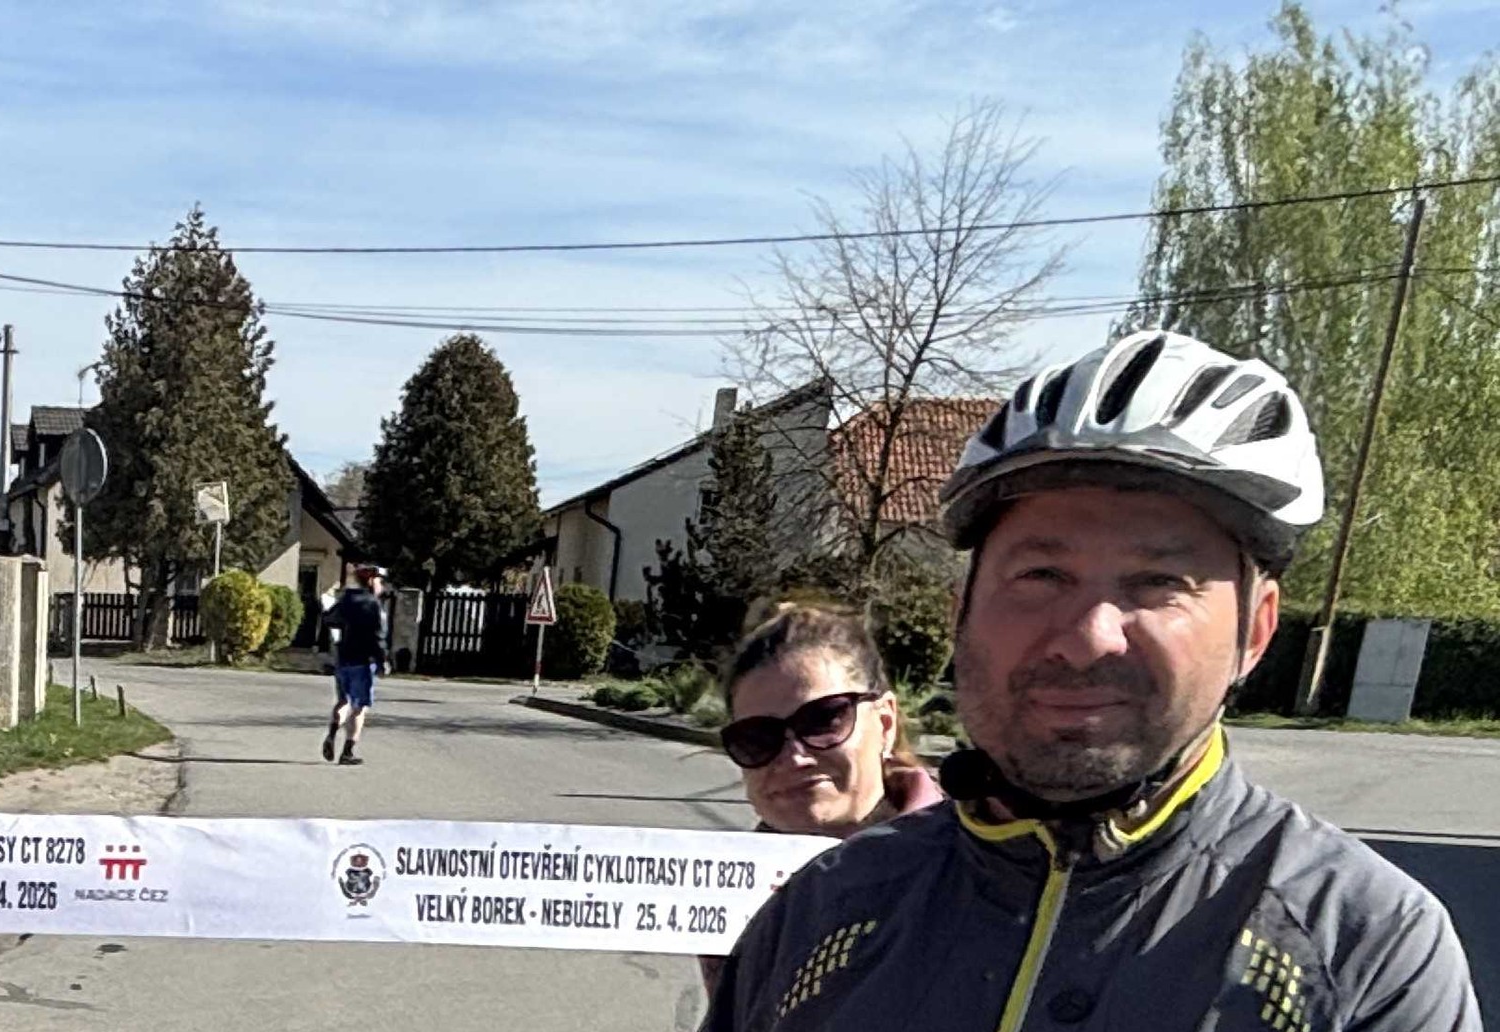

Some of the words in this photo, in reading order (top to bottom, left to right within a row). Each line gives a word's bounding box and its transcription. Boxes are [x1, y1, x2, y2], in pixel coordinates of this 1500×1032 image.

[21, 836, 42, 864] CT
[46, 837, 86, 865] 8278
[395, 840, 497, 879] SLAVNOSTNÍ
[500, 843, 581, 882] OTEVŘENÍ
[583, 853, 688, 888] CYKLOTRASY
[693, 859, 713, 888] CT
[717, 860, 756, 890] 8278
[17, 881, 58, 910] 2026
[74, 888, 137, 902] NADACE
[138, 887, 170, 903] ČEZ
[415, 886, 467, 923] VELKÝ
[471, 896, 527, 926] BOREK
[540, 892, 623, 930] NEBUŽELY
[636, 902, 662, 932] 25.
[667, 904, 683, 933] 4.
[688, 905, 728, 935] 2026
